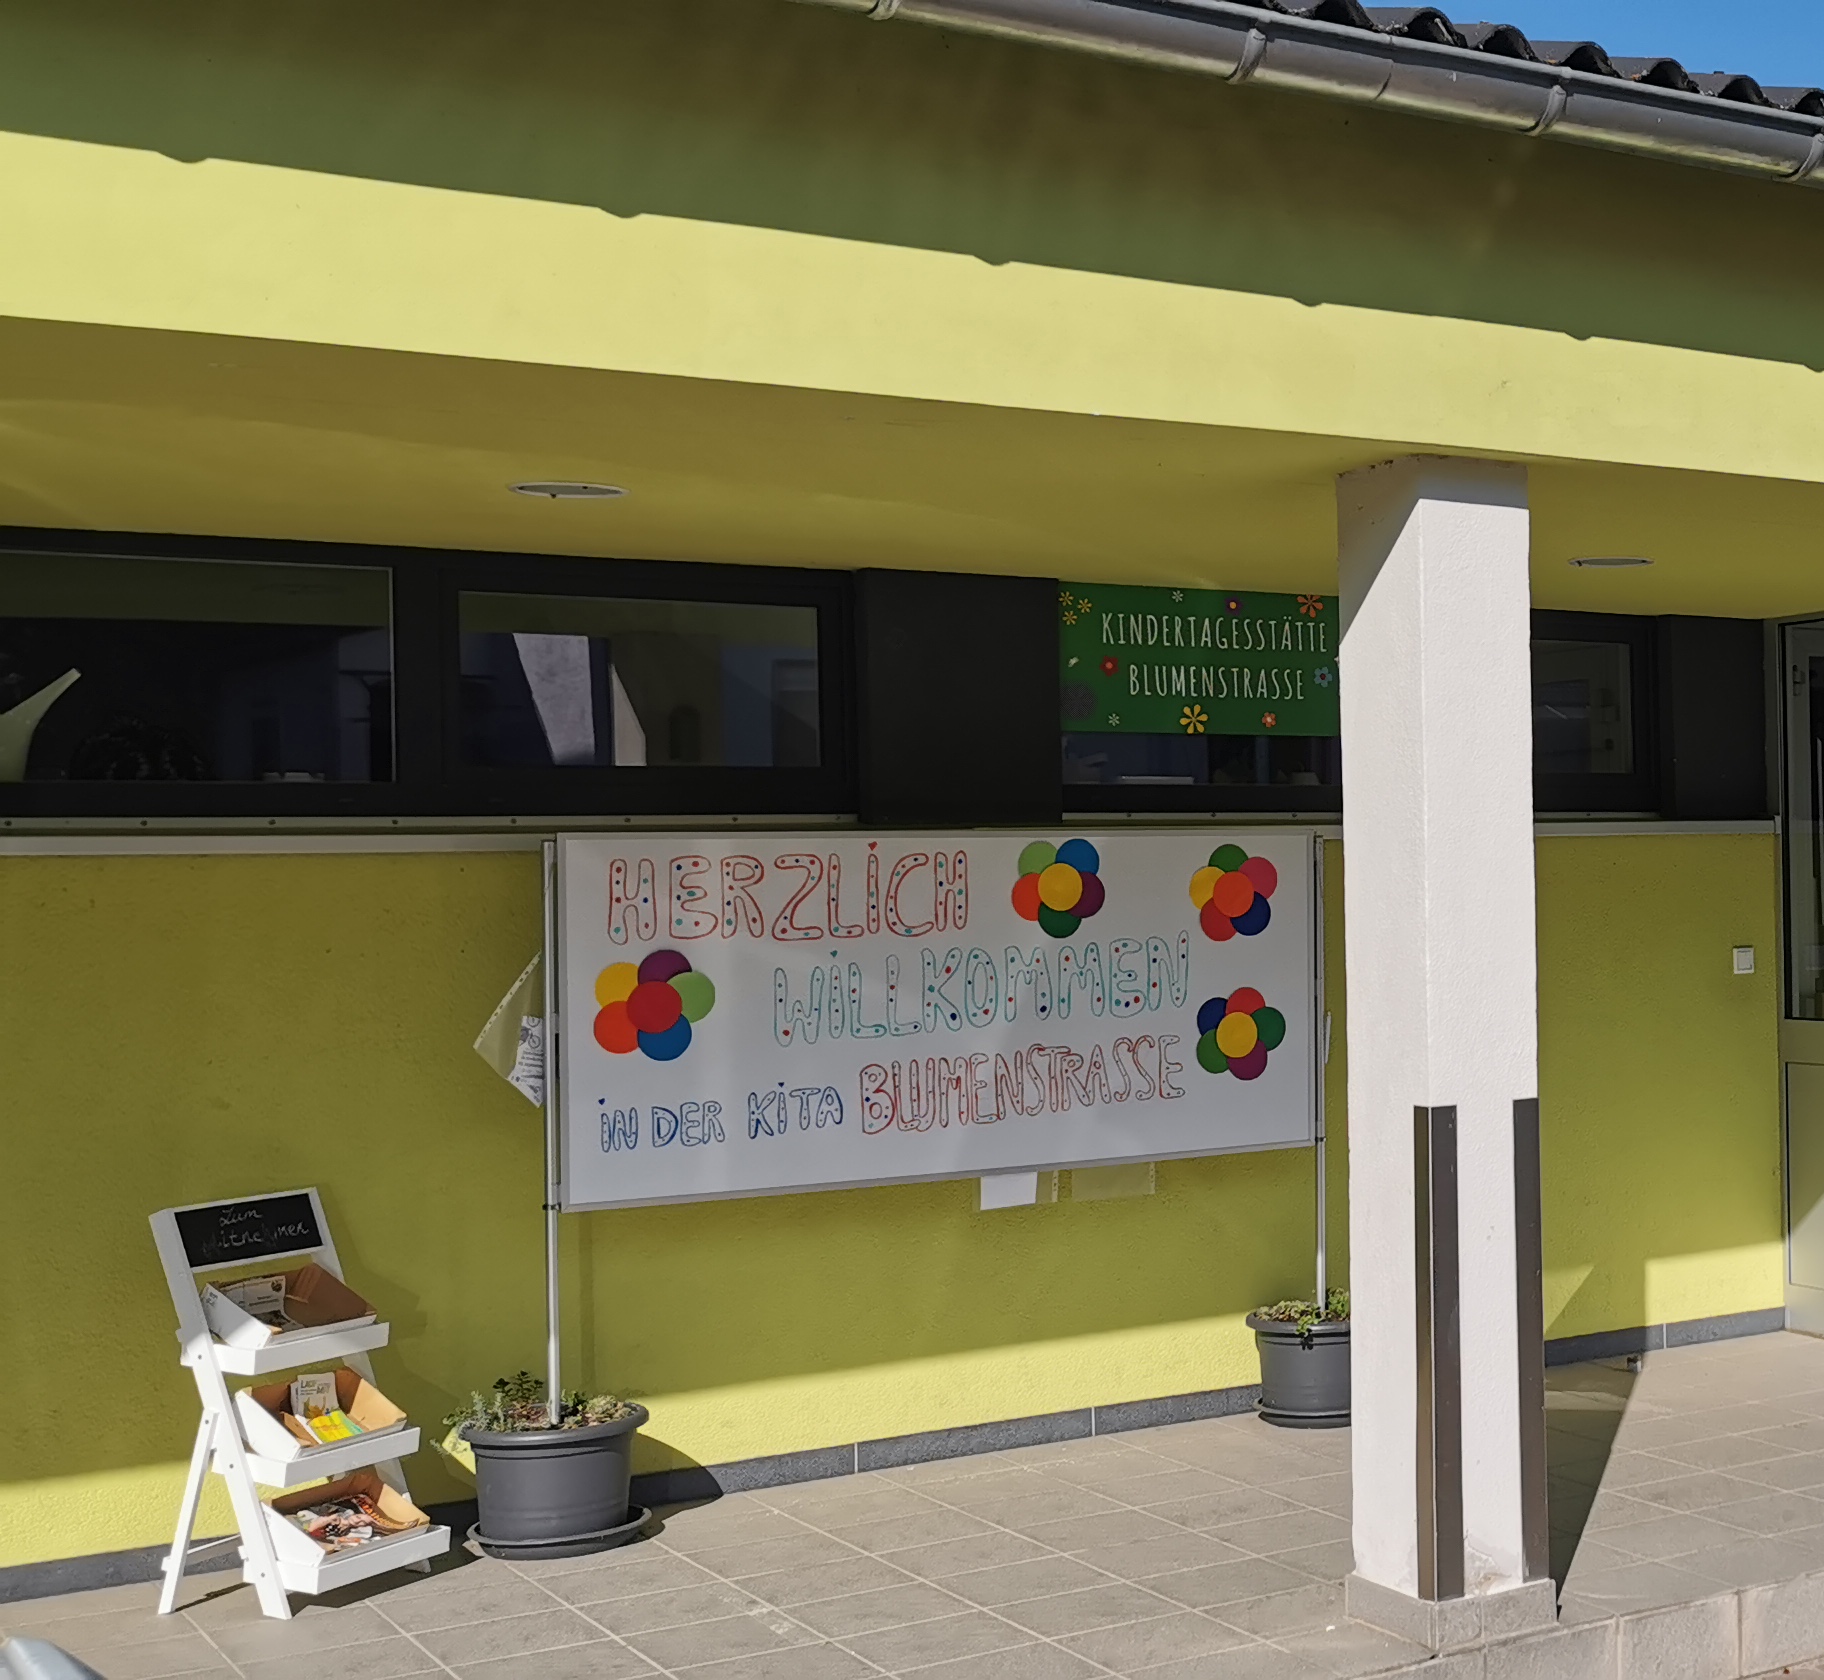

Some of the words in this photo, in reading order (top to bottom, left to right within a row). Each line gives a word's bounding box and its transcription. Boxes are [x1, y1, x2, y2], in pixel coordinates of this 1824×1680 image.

[1101, 612, 1328, 652] KINDERTAGESSTÄTTE
[1129, 664, 1305, 700] BLUMENSTRASSE
[651, 1100, 726, 1148] DER
[859, 1034, 1186, 1135] BLUMENSTRASSE
[219, 1206, 263, 1227] Zum
